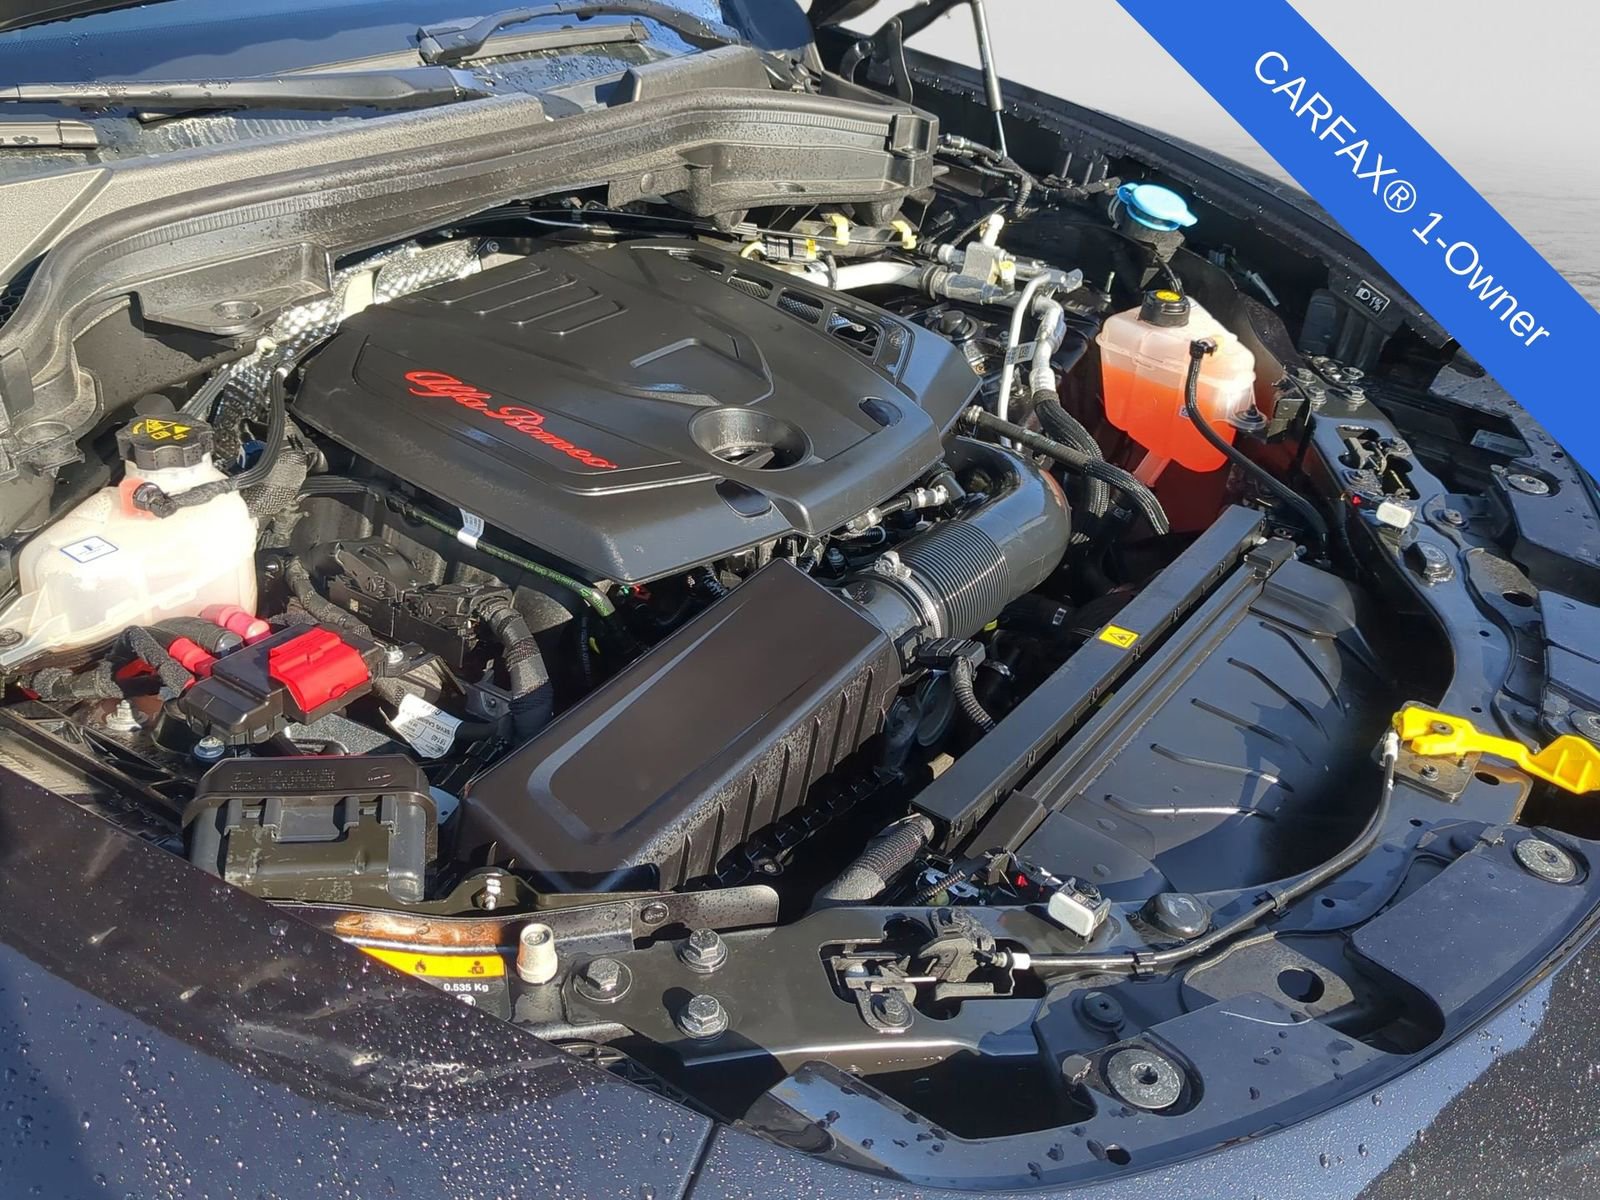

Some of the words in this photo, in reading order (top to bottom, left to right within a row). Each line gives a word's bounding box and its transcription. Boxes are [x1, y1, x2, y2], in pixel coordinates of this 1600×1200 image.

[404, 370, 492, 411] Alfa
[483, 407, 618, 469] Romeo
[443, 983, 471, 992] 0.535
[474, 983, 489, 993] Kg
